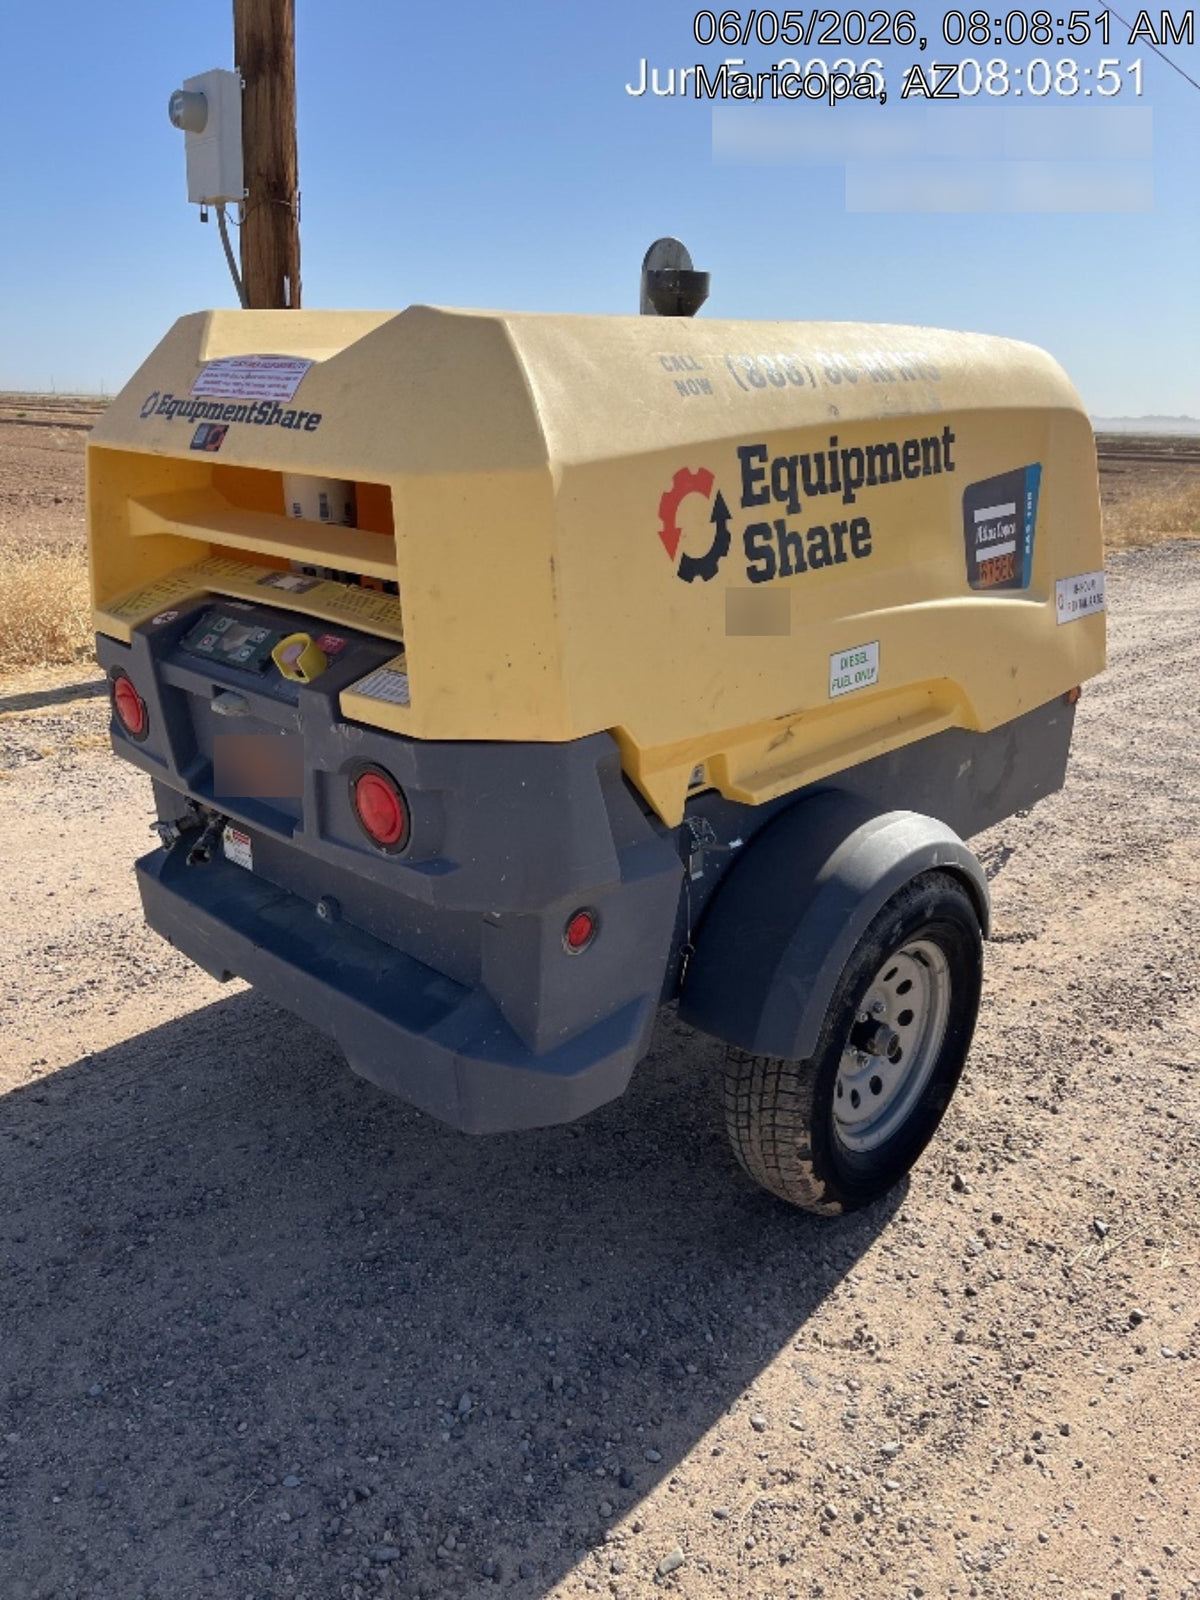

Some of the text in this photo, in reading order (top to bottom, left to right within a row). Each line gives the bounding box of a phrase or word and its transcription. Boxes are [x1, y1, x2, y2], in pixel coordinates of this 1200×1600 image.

[659, 355, 702, 372] CALL
[674, 377, 713, 397] NOW
[155, 394, 322, 431] EquipmentShare
[737, 426, 956, 515] Equipment
[742, 516, 873, 584] Share
[840, 651, 868, 670] DIESEL
[832, 667, 876, 691] FUEL ONLY
